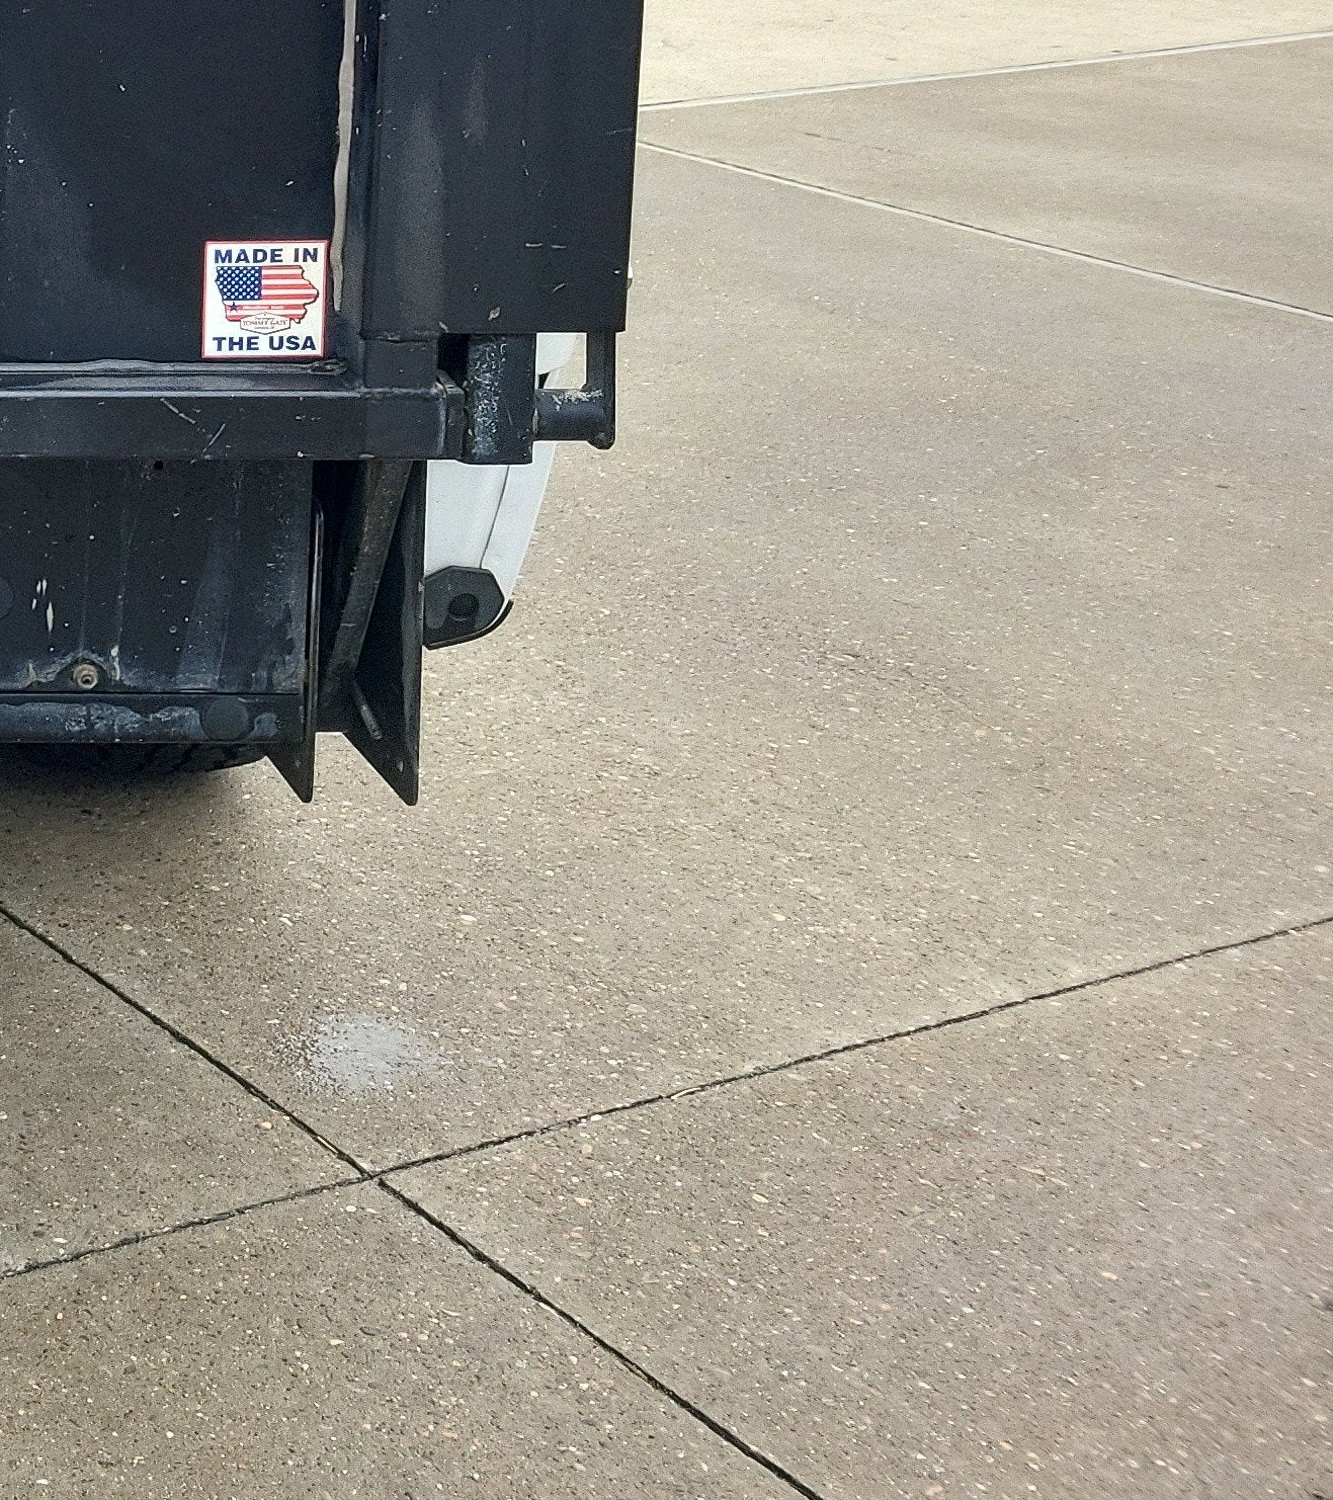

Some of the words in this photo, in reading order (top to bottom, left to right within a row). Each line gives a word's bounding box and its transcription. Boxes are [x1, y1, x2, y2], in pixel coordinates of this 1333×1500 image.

[214, 248, 283, 264] MADE
[293, 247, 318, 263] IN
[212, 336, 259, 351] THE
[269, 336, 316, 351] USA
